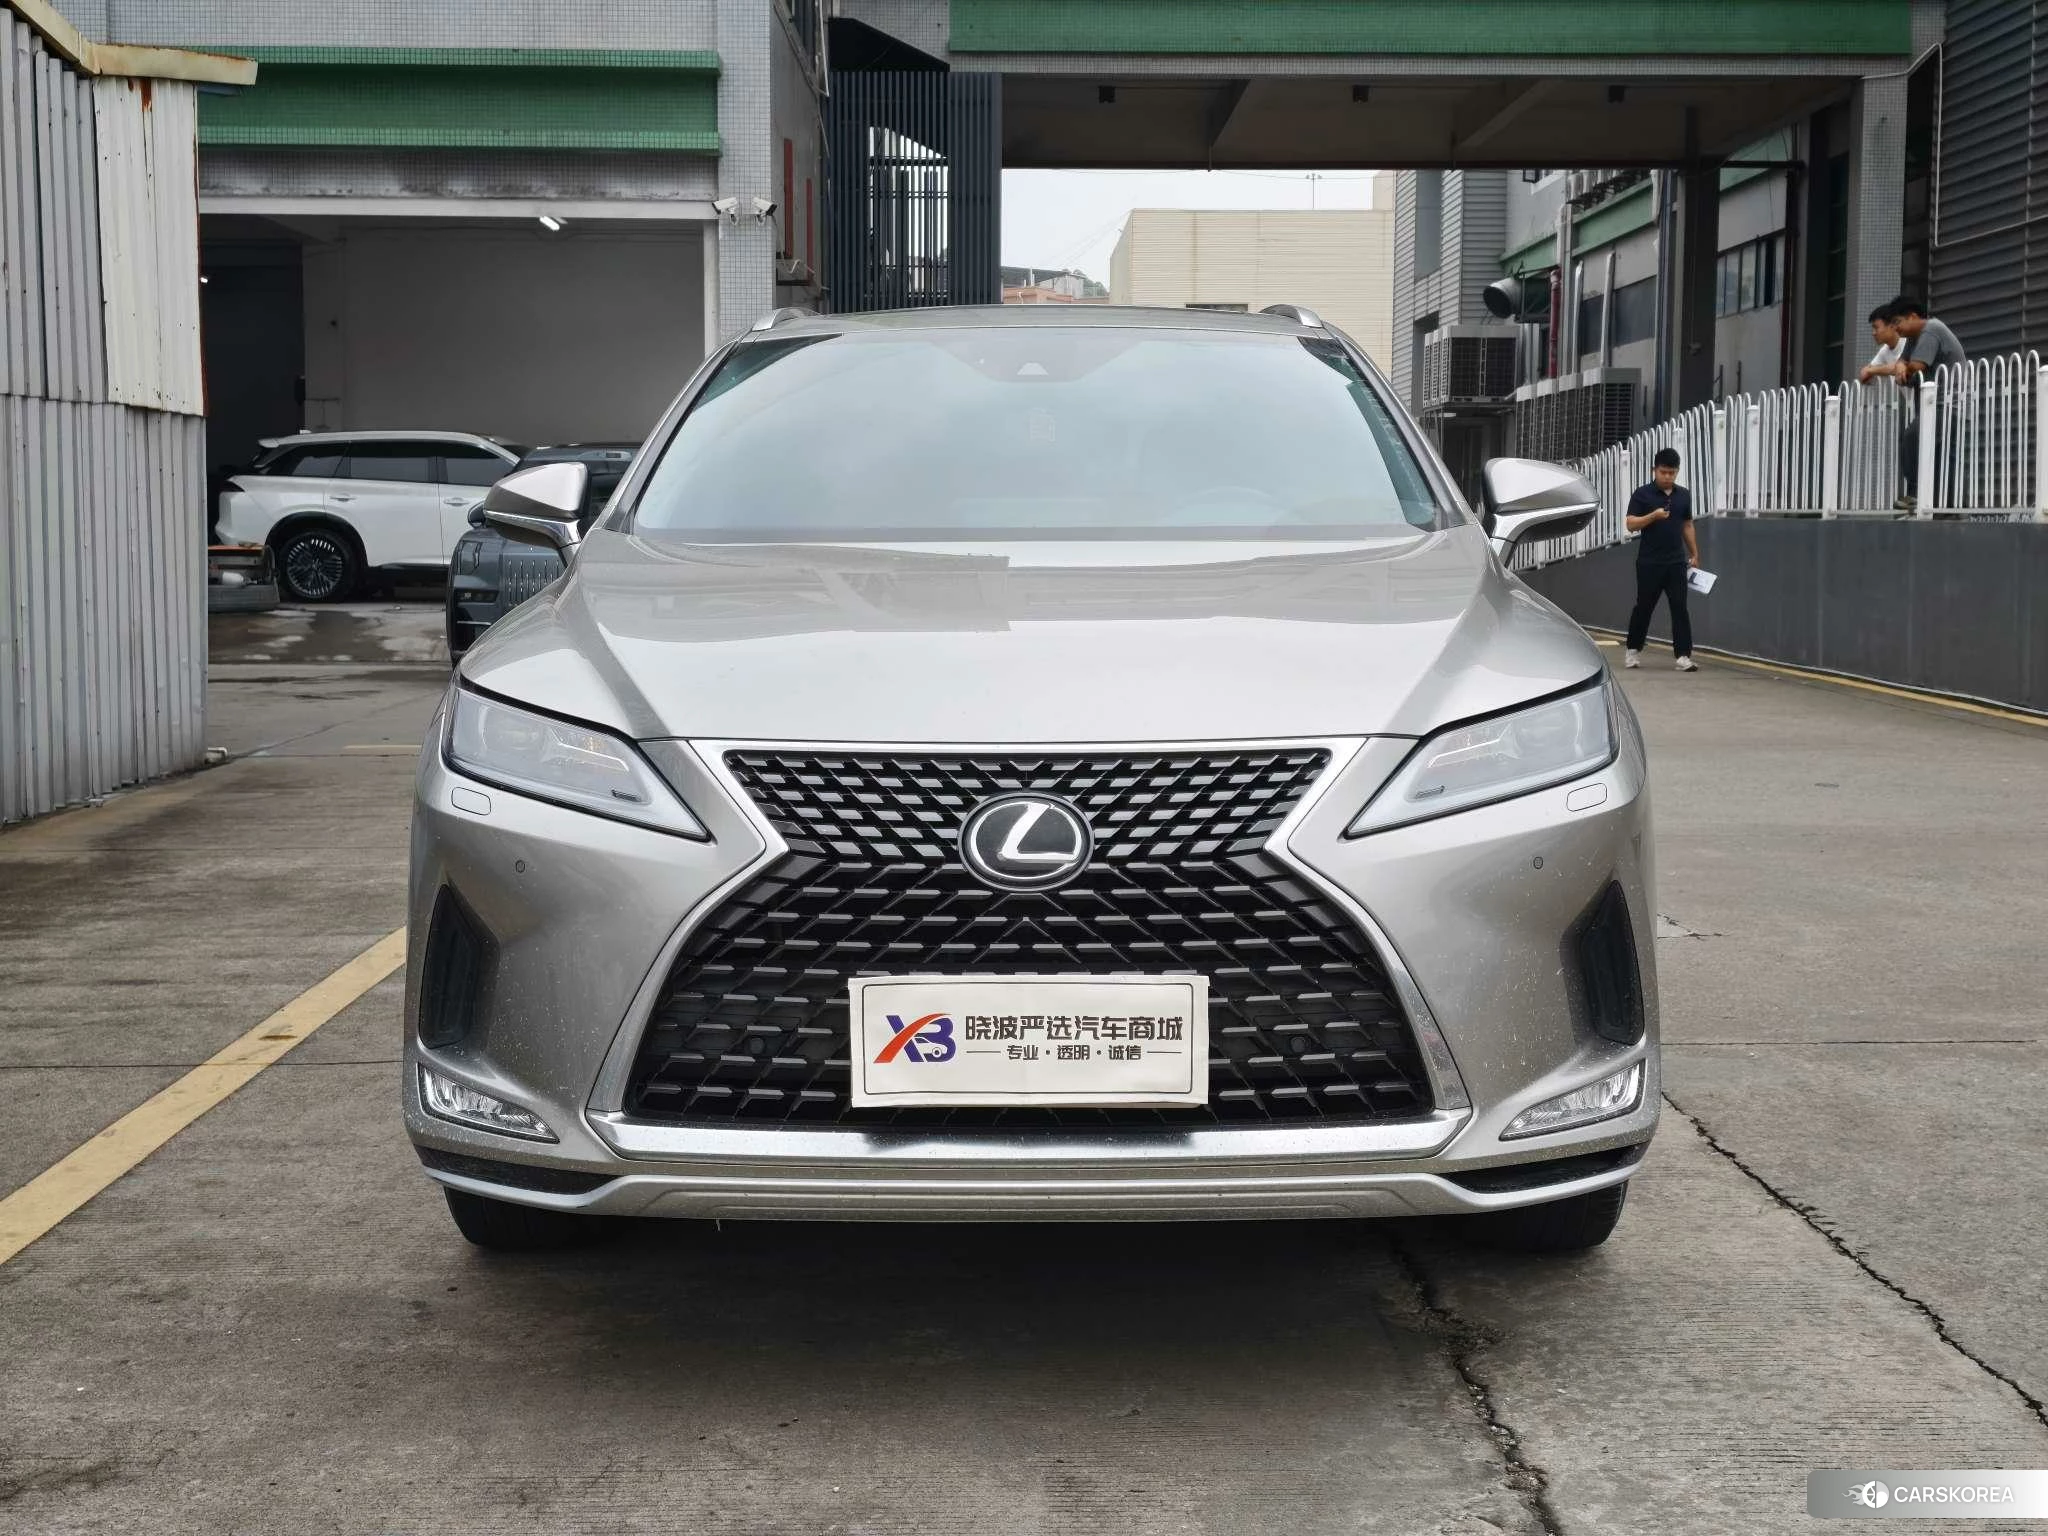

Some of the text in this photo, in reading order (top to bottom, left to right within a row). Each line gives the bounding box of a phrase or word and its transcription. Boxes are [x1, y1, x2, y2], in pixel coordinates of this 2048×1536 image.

[965, 1015, 1183, 1041] 晓波严选汽车商城
